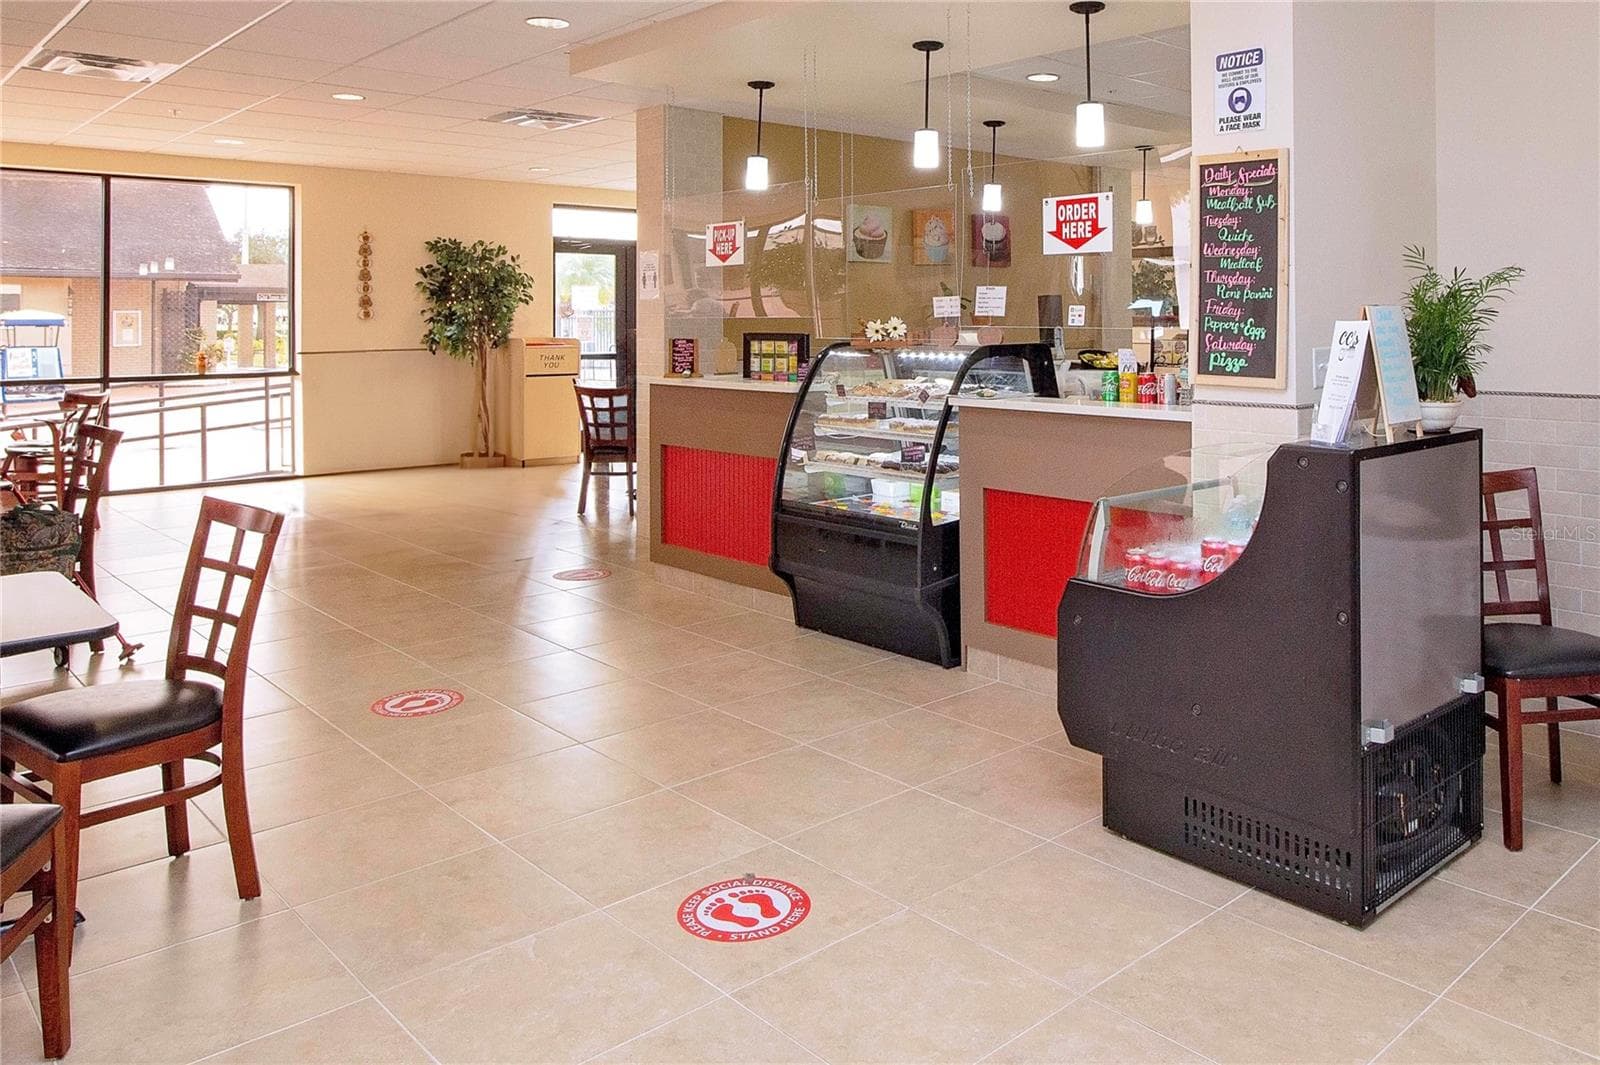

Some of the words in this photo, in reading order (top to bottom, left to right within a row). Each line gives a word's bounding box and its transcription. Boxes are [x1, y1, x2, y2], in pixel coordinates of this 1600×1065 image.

[1220, 51, 1260, 70] NOTICE
[1218, 115, 1241, 124] PLEASE
[1242, 112, 1262, 122] WEAR
[1226, 123, 1240, 132] FACE
[1242, 120, 1261, 129] MASK
[1204, 166, 1234, 183] Daily
[1058, 202, 1096, 222] ORDER
[1206, 197, 1253, 212] Meatball
[1256, 194, 1278, 214] Sub
[714, 229, 736, 242] PICK-UP
[1062, 221, 1092, 239] HERE
[716, 242, 733, 254] HERE
[1220, 257, 1263, 272] Meatloaf
[1204, 316, 1239, 334] Peppers
[1244, 318, 1266, 340] Eggs
[702, 880, 748, 896] SOCIAL
[752, 879, 803, 902] DISTANCE
[682, 894, 702, 914] KEEP
[682, 913, 712, 937] PLEASE
[730, 926, 780, 940] STAND
[782, 906, 806, 928] HERE
